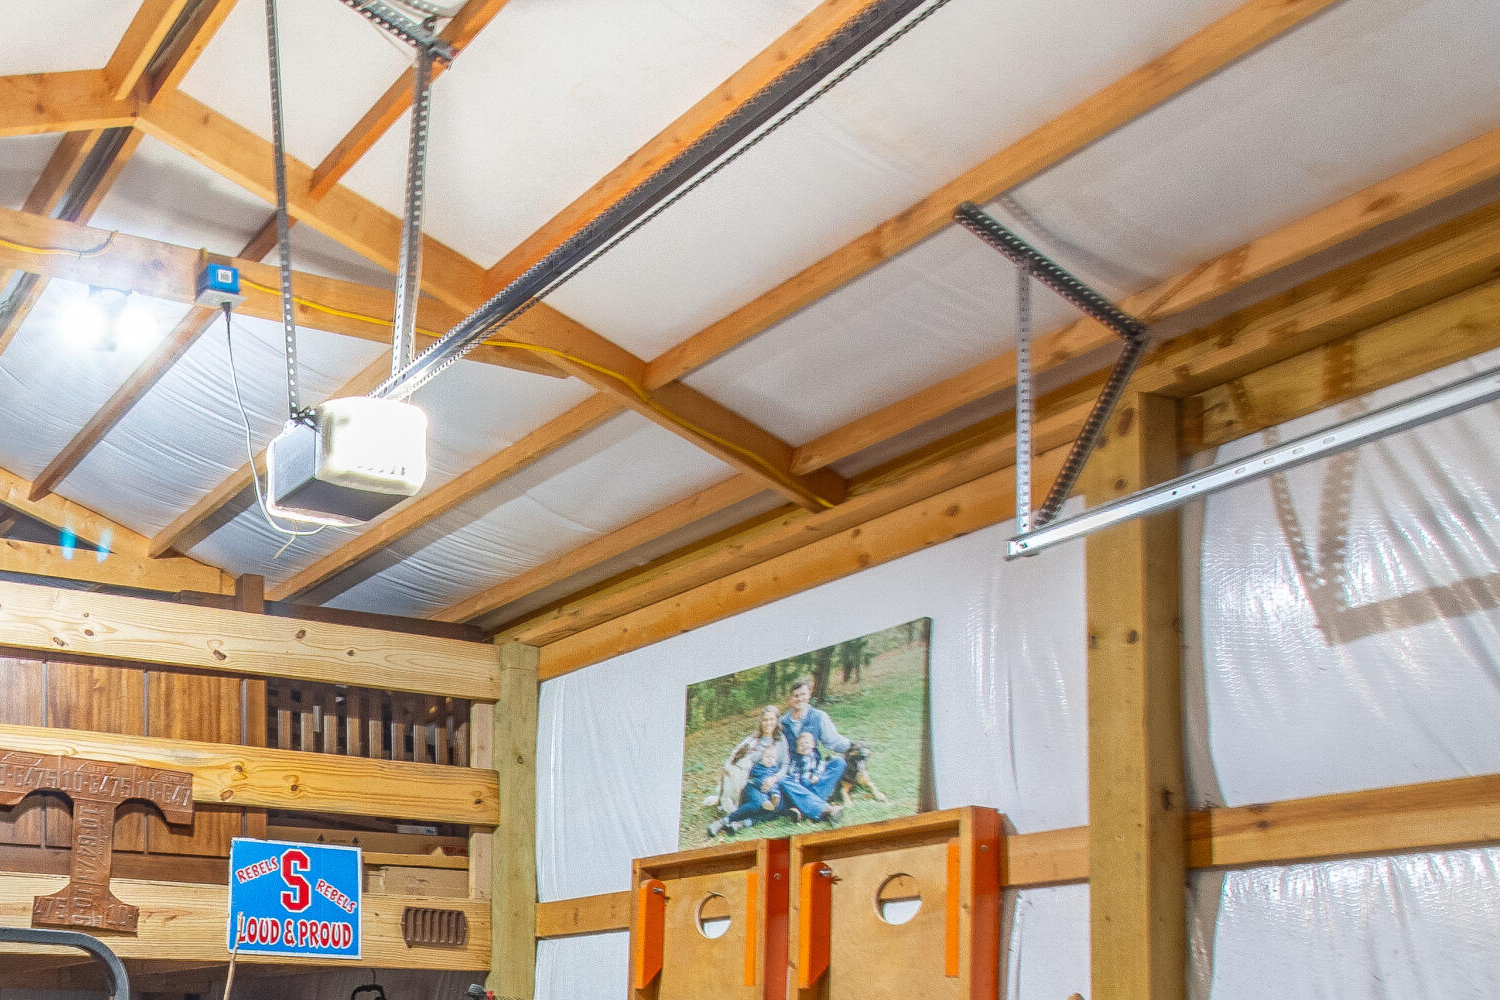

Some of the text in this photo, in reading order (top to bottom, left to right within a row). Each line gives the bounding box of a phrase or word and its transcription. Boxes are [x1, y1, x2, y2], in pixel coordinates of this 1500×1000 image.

[236, 856, 279, 884] REBELS
[280, 848, 311, 912] S
[315, 878, 357, 914] REBELS
[237, 917, 353, 949] LOUD & PROUD
